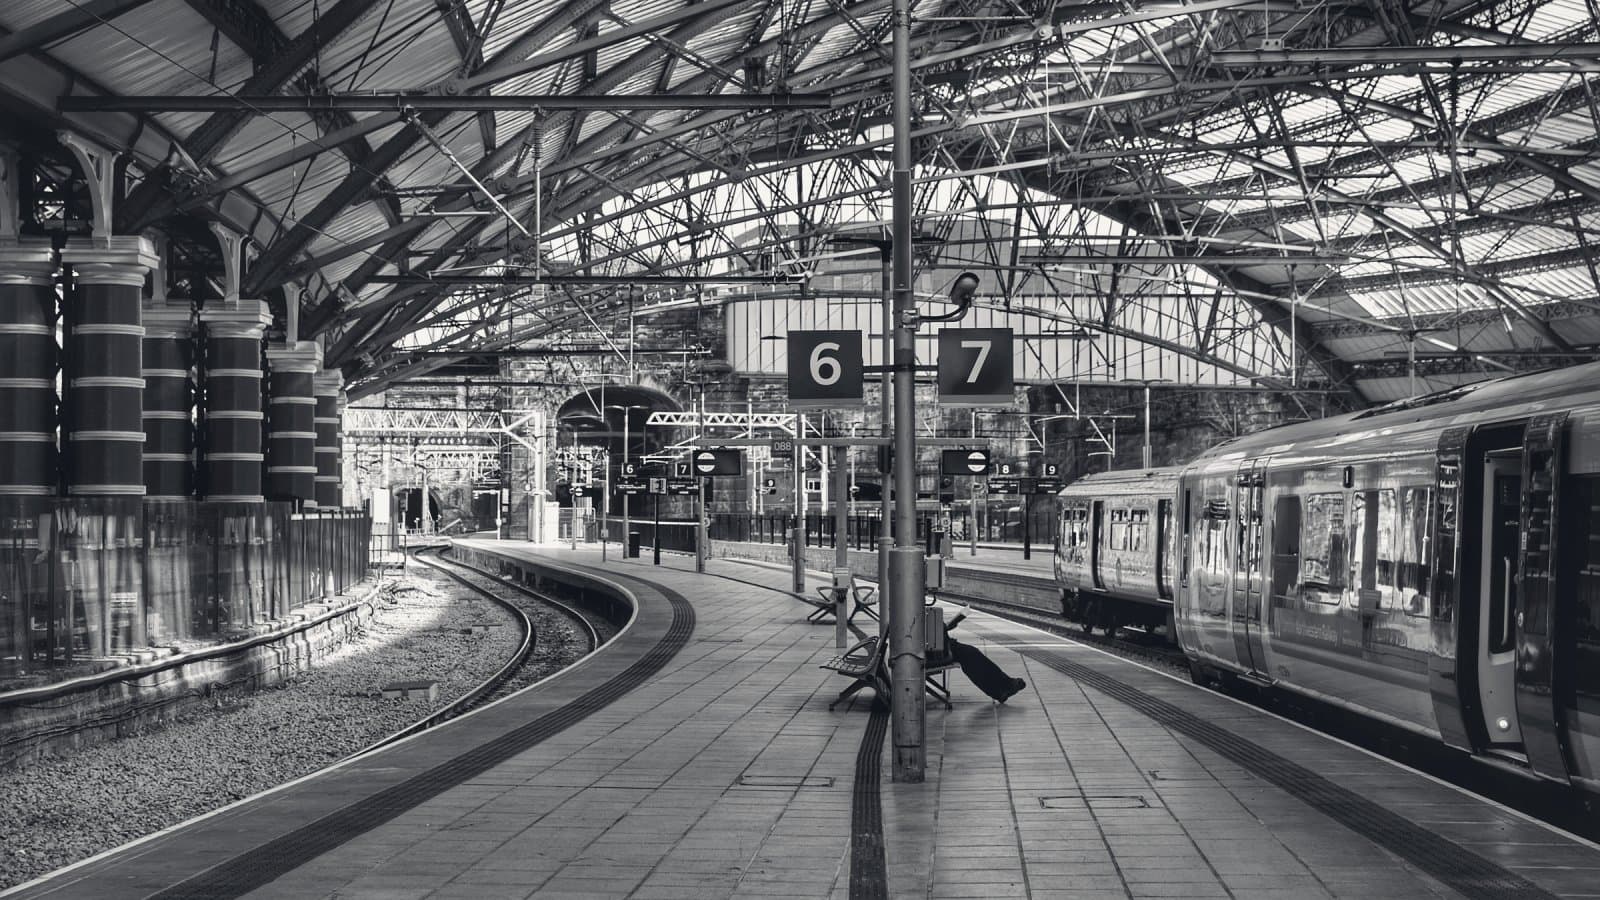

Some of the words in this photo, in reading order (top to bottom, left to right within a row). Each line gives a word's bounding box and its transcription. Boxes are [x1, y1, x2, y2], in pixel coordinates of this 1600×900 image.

[809, 341, 842, 386] 6
[960, 340, 992, 384] 7
[626, 464, 634, 474] 6
[680, 464, 687, 474] 7
[1002, 464, 1010, 474] 8
[1048, 465, 1056, 475] 9
